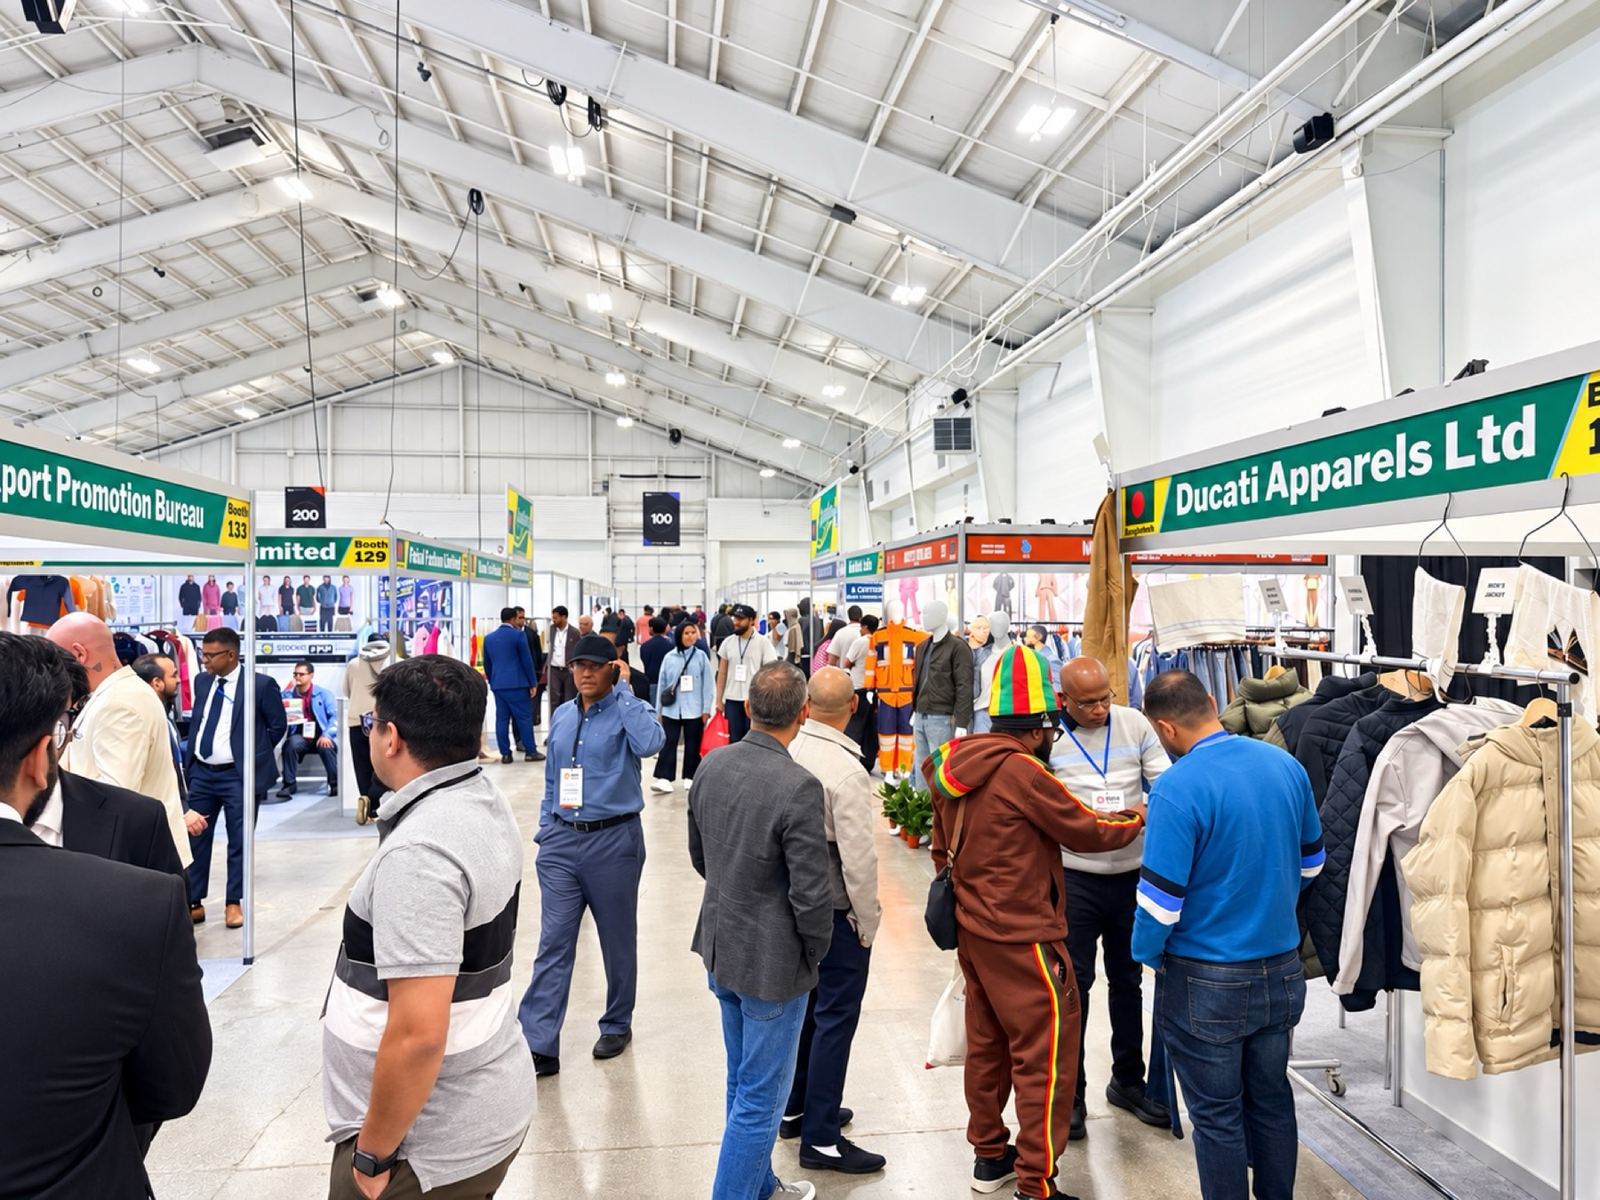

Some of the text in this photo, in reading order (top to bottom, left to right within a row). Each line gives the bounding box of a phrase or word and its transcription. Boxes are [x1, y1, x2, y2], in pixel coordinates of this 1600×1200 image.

[1176, 465, 1259, 516] Ducati
[1265, 432, 1433, 506] Apparels
[1445, 403, 1536, 471] Ltd
[0, 463, 204, 529] port Promotion Bureau
[228, 502, 249, 517] Booth
[292, 509, 319, 521] 200
[650, 513, 673, 525] 100
[228, 520, 247, 540] 133
[254, 542, 336, 560] imited
[354, 540, 388, 549] Booth
[355, 551, 387, 562] 129
